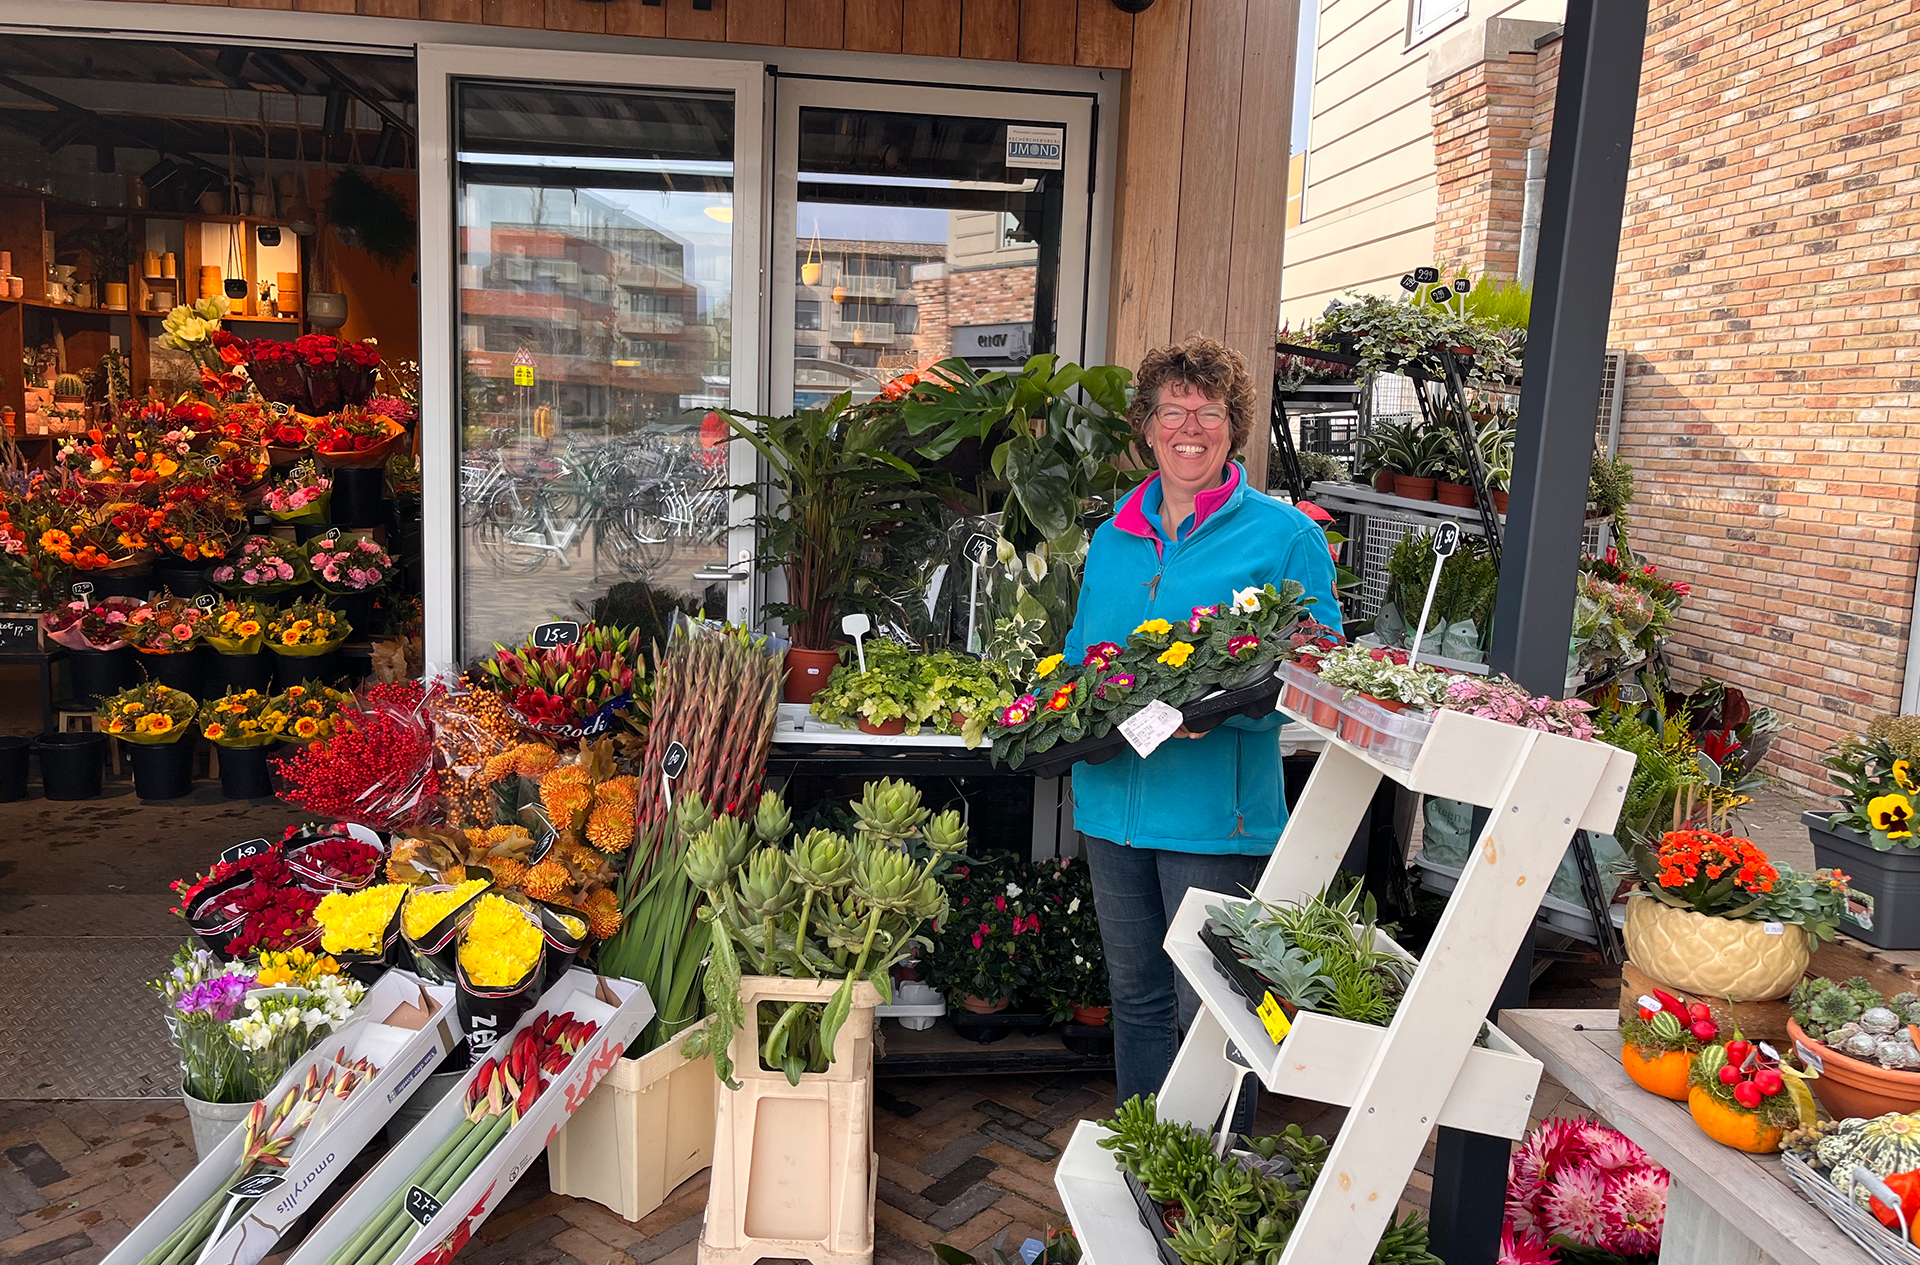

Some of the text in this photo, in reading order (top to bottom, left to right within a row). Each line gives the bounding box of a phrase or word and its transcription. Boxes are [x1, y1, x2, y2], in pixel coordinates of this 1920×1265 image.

[548, 711, 608, 738] Rock
[1430, 801, 1462, 823] Green
[276, 1152, 335, 1214] amaryllis
